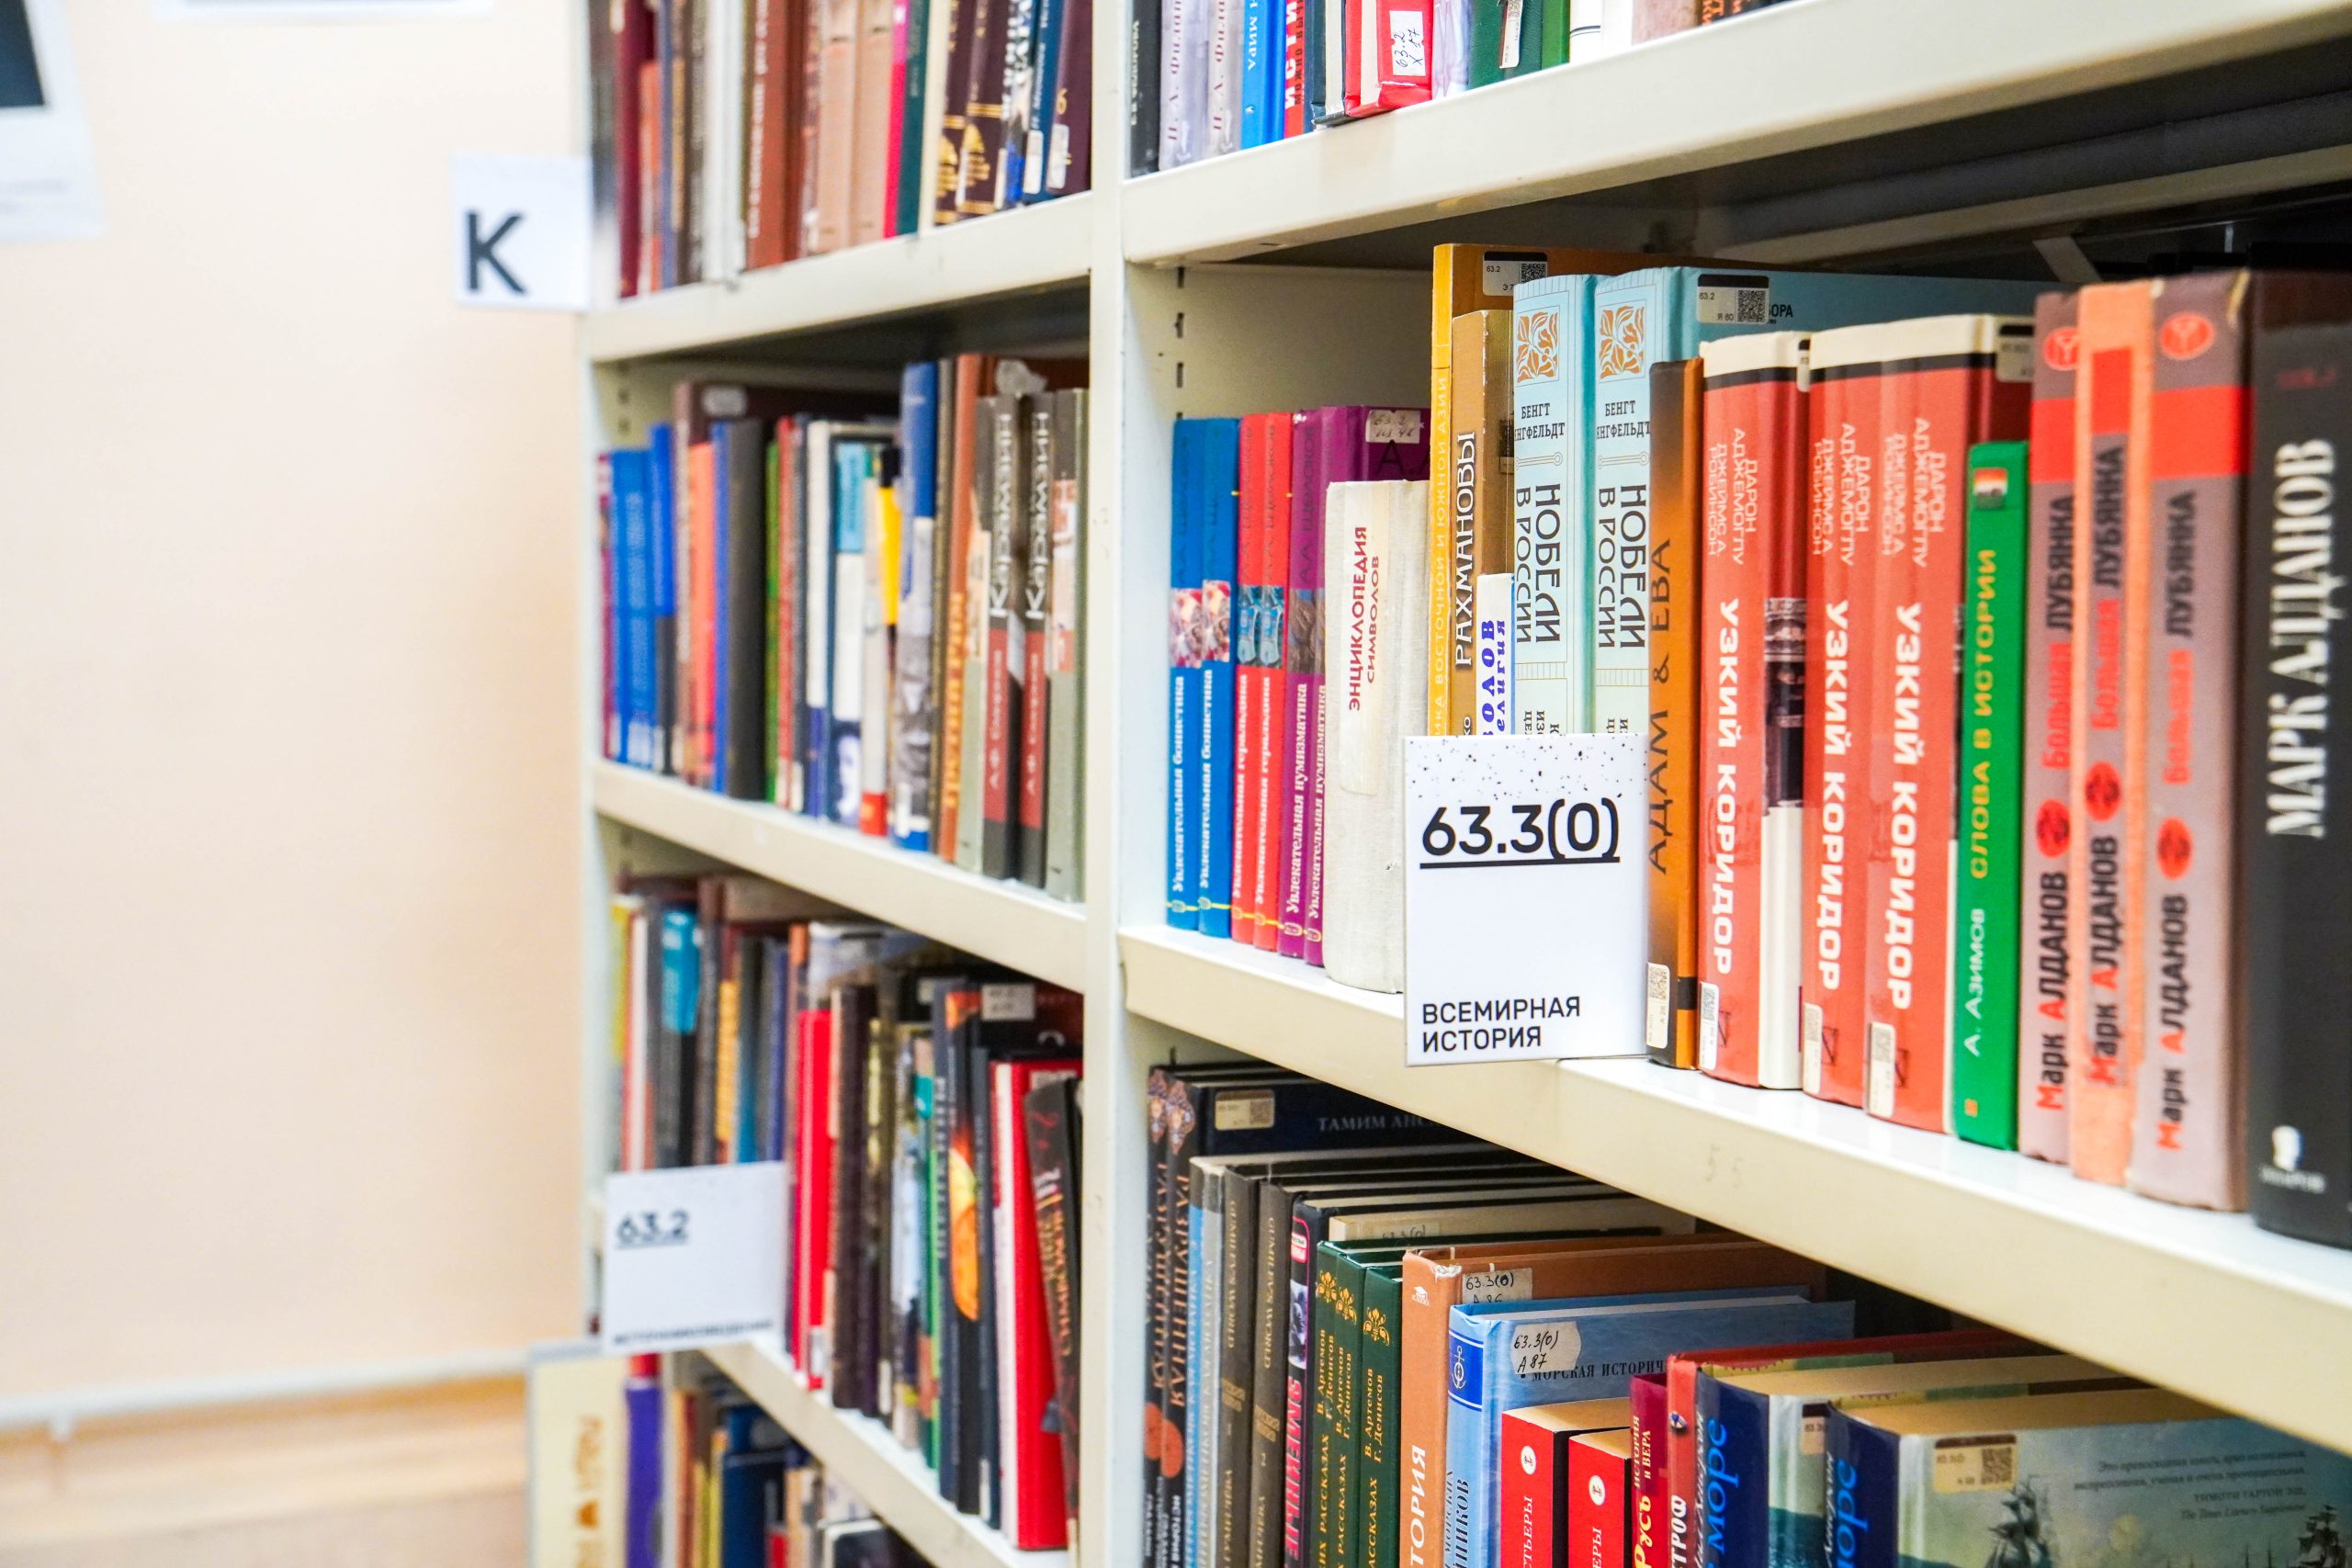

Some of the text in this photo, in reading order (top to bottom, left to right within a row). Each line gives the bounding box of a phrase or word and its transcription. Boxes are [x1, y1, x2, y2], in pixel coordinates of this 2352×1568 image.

[1248, 17, 1258, 72] МИРА
[1285, 0, 1297, 110] ИСТИ
[1486, 265, 1501, 273] 63.2
[1437, 377, 1447, 434] АЗИИ
[1521, 402, 1551, 420] БЕНГТ
[1604, 400, 1636, 417] БЕНГТ
[1436, 441, 1447, 528] ЮЖНОЙ
[1707, 446, 1718, 556] РОБИНСОН
[1716, 443, 1728, 536] ДЖЕЙМС
[1732, 427, 1745, 566] АДЖЕМОГЛУ
[1746, 458, 1758, 533] ДАРОН
[1854, 456, 1871, 532] ДАРОН
[2093, 446, 2124, 590] ЛУБЯНКА
[1436, 534, 1446, 547] И
[1455, 431, 1476, 667] РАХМАНОВЫ
[1516, 486, 1532, 644] В РОССИИ
[1535, 483, 1561, 643] НОБЕЛИ
[1599, 487, 1616, 649] В РОССИИ
[1620, 484, 1647, 649] НОБЕЛИ
[2046, 493, 2074, 633] ЛУБЯНКА
[2165, 489, 2197, 637] ЛУБЯНКА
[2271, 439, 2349, 685] АЛДАНОВ
[1349, 525, 1368, 712] ЭНЦИКЛОПЕДИЯ
[1367, 555, 1380, 684] СИМВОЛОВ
[1435, 557, 1447, 684] ВОСТОЧНОЙ
[1974, 549, 1996, 716] ИСТОРИИ
[1497, 620, 1506, 733] елигия
[1649, 538, 1673, 874] АДАМ & ЕВА
[1172, 675, 1185, 892] Увлекательная бонистика
[1199, 669, 1213, 888] Увлекательная бонистика
[1255, 676, 1272, 904] Увлекательная геральдика
[1712, 598, 1743, 976] УЗКИЙ КОРИДОР
[1973, 728, 1992, 750] В
[2266, 694, 2330, 840] МАРК
[1232, 773, 1246, 898] Увлекательная
[1286, 682, 1308, 914] Увлекательная нумизматика
[1421, 796, 1620, 861] 63.3(0)
[1816, 600, 1852, 990] УЗКИЙ КОРИДОР
[1884, 602, 1925, 1010] УЗКИЙ КОРИДОР
[1307, 797, 1324, 919] Увлекательная
[1423, 996, 1581, 1025] ВСЕМИРНАЯ
[1965, 908, 1985, 1020] АЗИМОВ
[2035, 872, 2070, 1111] Марк АЛДАНОВ
[2087, 835, 2125, 1085] Марк АЛДАНОВ
[1423, 1026, 1542, 1053] ИСТОРИЯ
[1964, 1026, 1981, 1057] А.
[2156, 894, 2191, 1151] Марк АЛДАНОВ
[1318, 1116, 1386, 1134] ТАМИМ
[1227, 1290, 1237, 1348] WORLD
[1263, 1216, 1276, 1369] GUMILEV'S WORLD
[1465, 1271, 1515, 1290] 63.3(0)
[1317, 1328, 1327, 1416] В. Артемов
[1325, 1334, 1335, 1403] Денисов
[1335, 1347, 1346, 1435] В. Артемов
[1343, 1352, 1352, 1422] Денисов
[1513, 1330, 1559, 1349] 63.3(0)
[1529, 1353, 1548, 1370] 87
[1601, 1359, 1665, 1377] ИСТОРИЧ
[1364, 1368, 1374, 1458] В. Артемов
[1374, 1373, 1384, 1463] Г. Денисов
[1633, 1415, 1641, 1489] ИСТОРИЯ
[1642, 1430, 1652, 1466] ВЕРА
[1318, 1433, 1330, 1534] РАССКАЗАХ
[1337, 1453, 1347, 1555] РАССКАЗАХ
[1367, 1476, 1378, 1568] АССКАЗАХ
[1410, 1444, 1426, 1567] ТОРИЯ
[1670, 1494, 1688, 1568] ТРОФ
[1706, 1417, 1739, 1555] море
[1591, 1526, 1602, 1568] ЕРЫ
